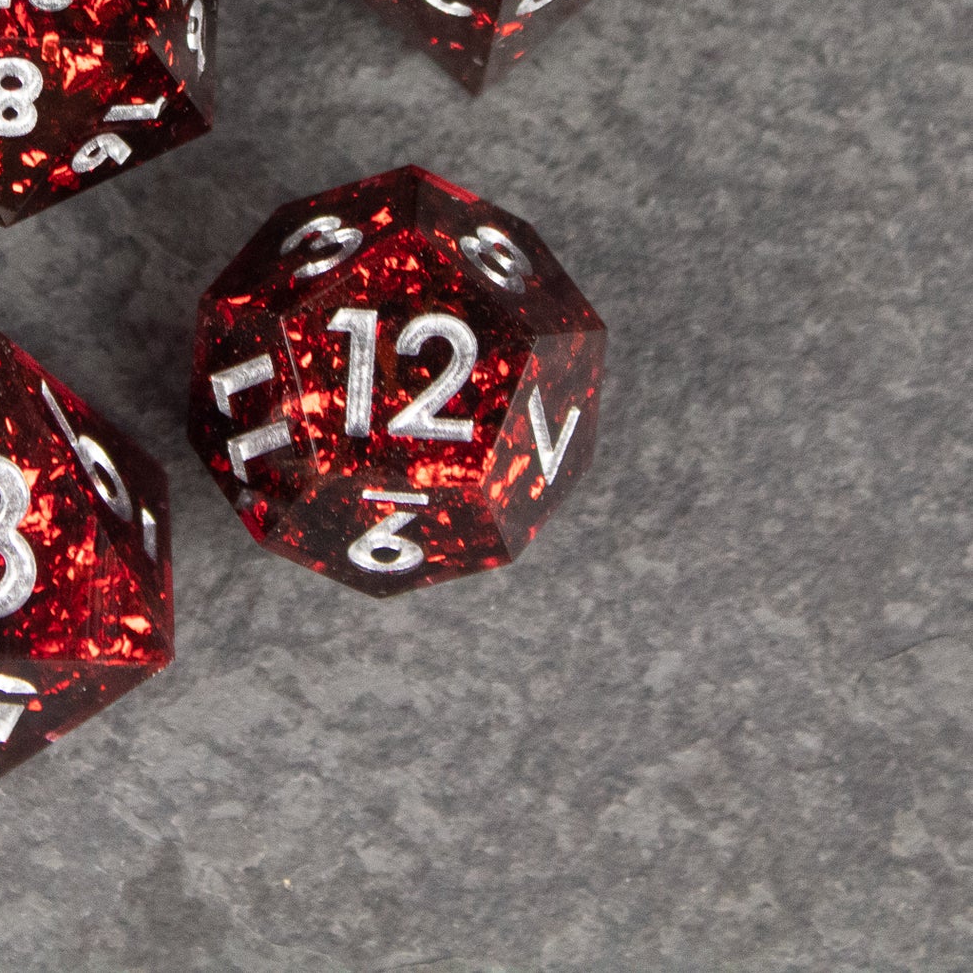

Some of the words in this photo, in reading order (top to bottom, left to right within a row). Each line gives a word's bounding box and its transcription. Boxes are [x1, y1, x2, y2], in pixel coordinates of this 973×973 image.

[71, 95, 168, 174] 16
[279, 214, 364, 279] 3
[458, 225, 534, 295] 8
[210, 352, 293, 484] 11
[326, 306, 479, 443] 12
[41, 379, 134, 524] 6
